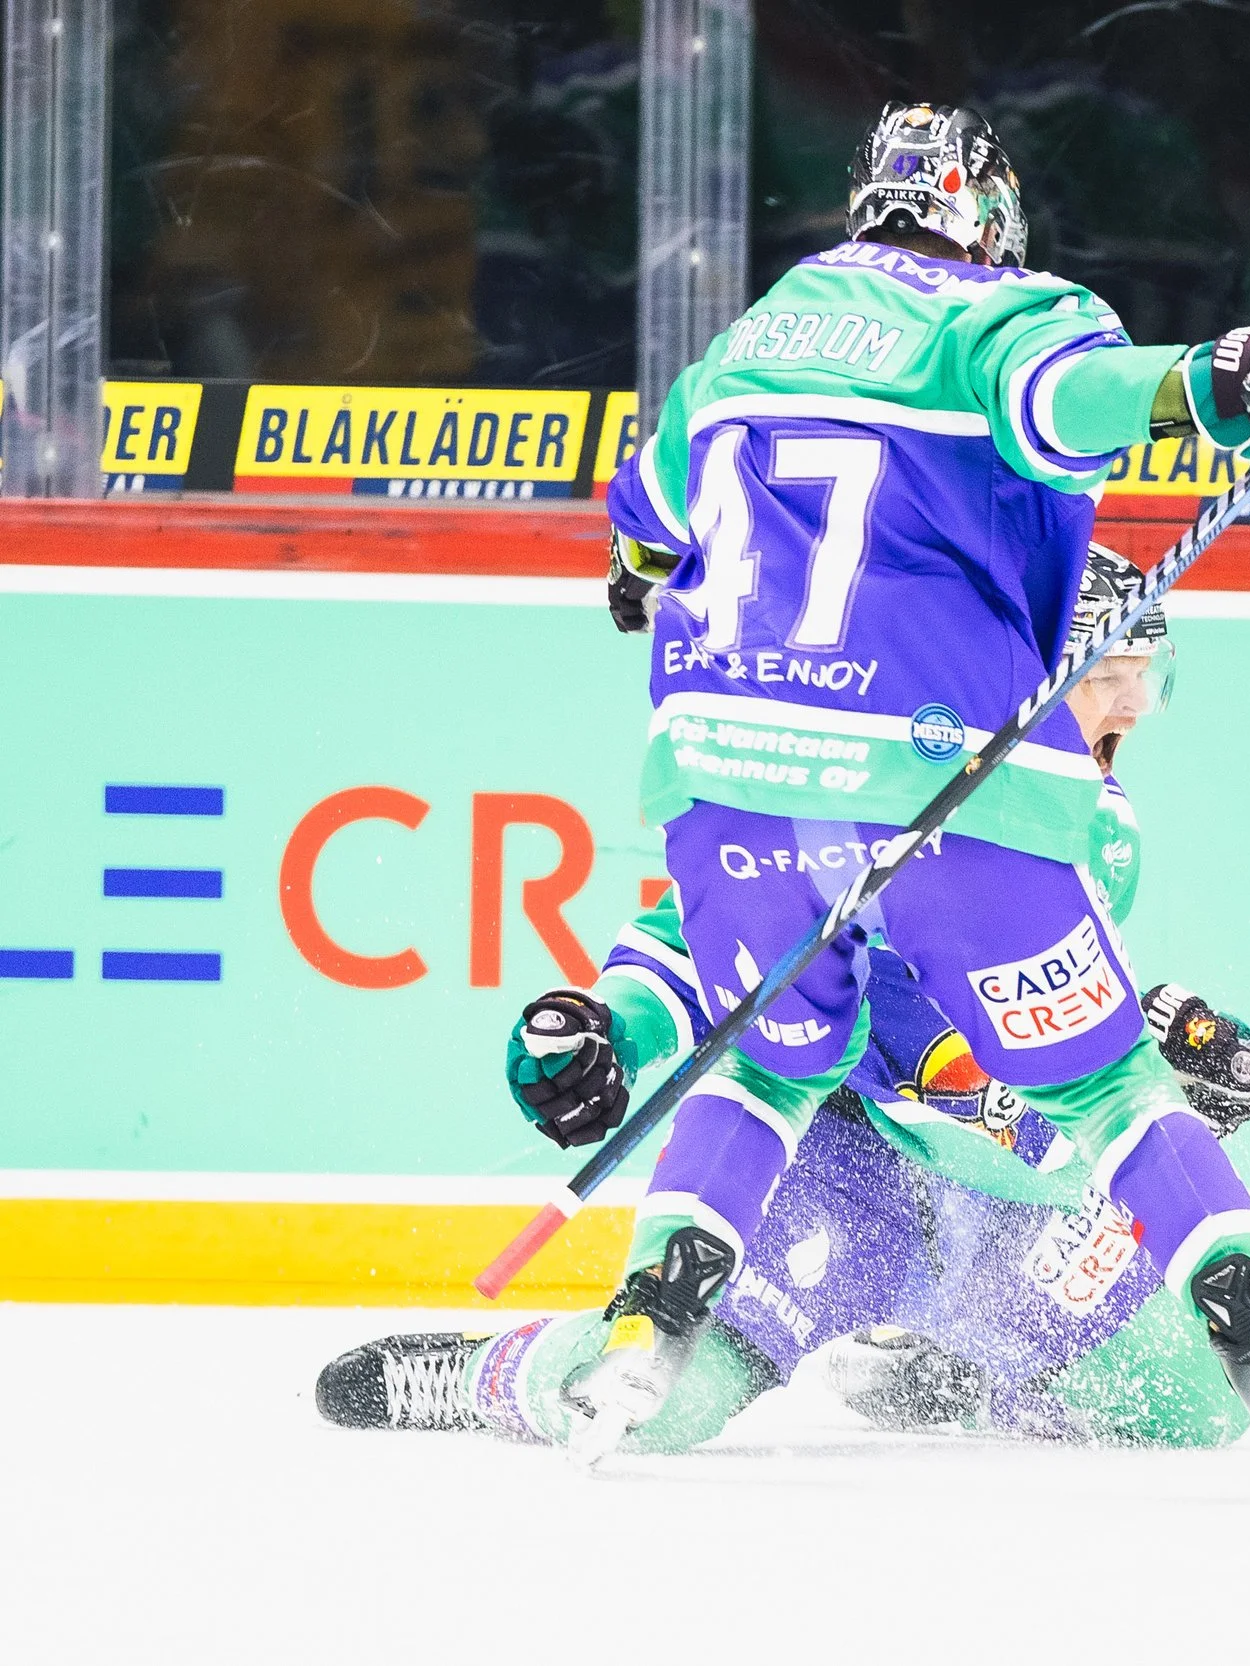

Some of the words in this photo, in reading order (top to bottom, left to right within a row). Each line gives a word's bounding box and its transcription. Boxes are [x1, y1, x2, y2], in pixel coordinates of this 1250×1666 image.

[878, 189, 926, 201] PAIKKA
[255, 393, 570, 467] BLÅKLÄDER
[660, 424, 886, 652] 47
[726, 652, 747, 680] &
[757, 651, 878, 696] ENJOY
[912, 722, 964, 744] MESTIS
[979, 926, 1100, 1004] CABLE
[1001, 966, 1113, 1040] CREW
